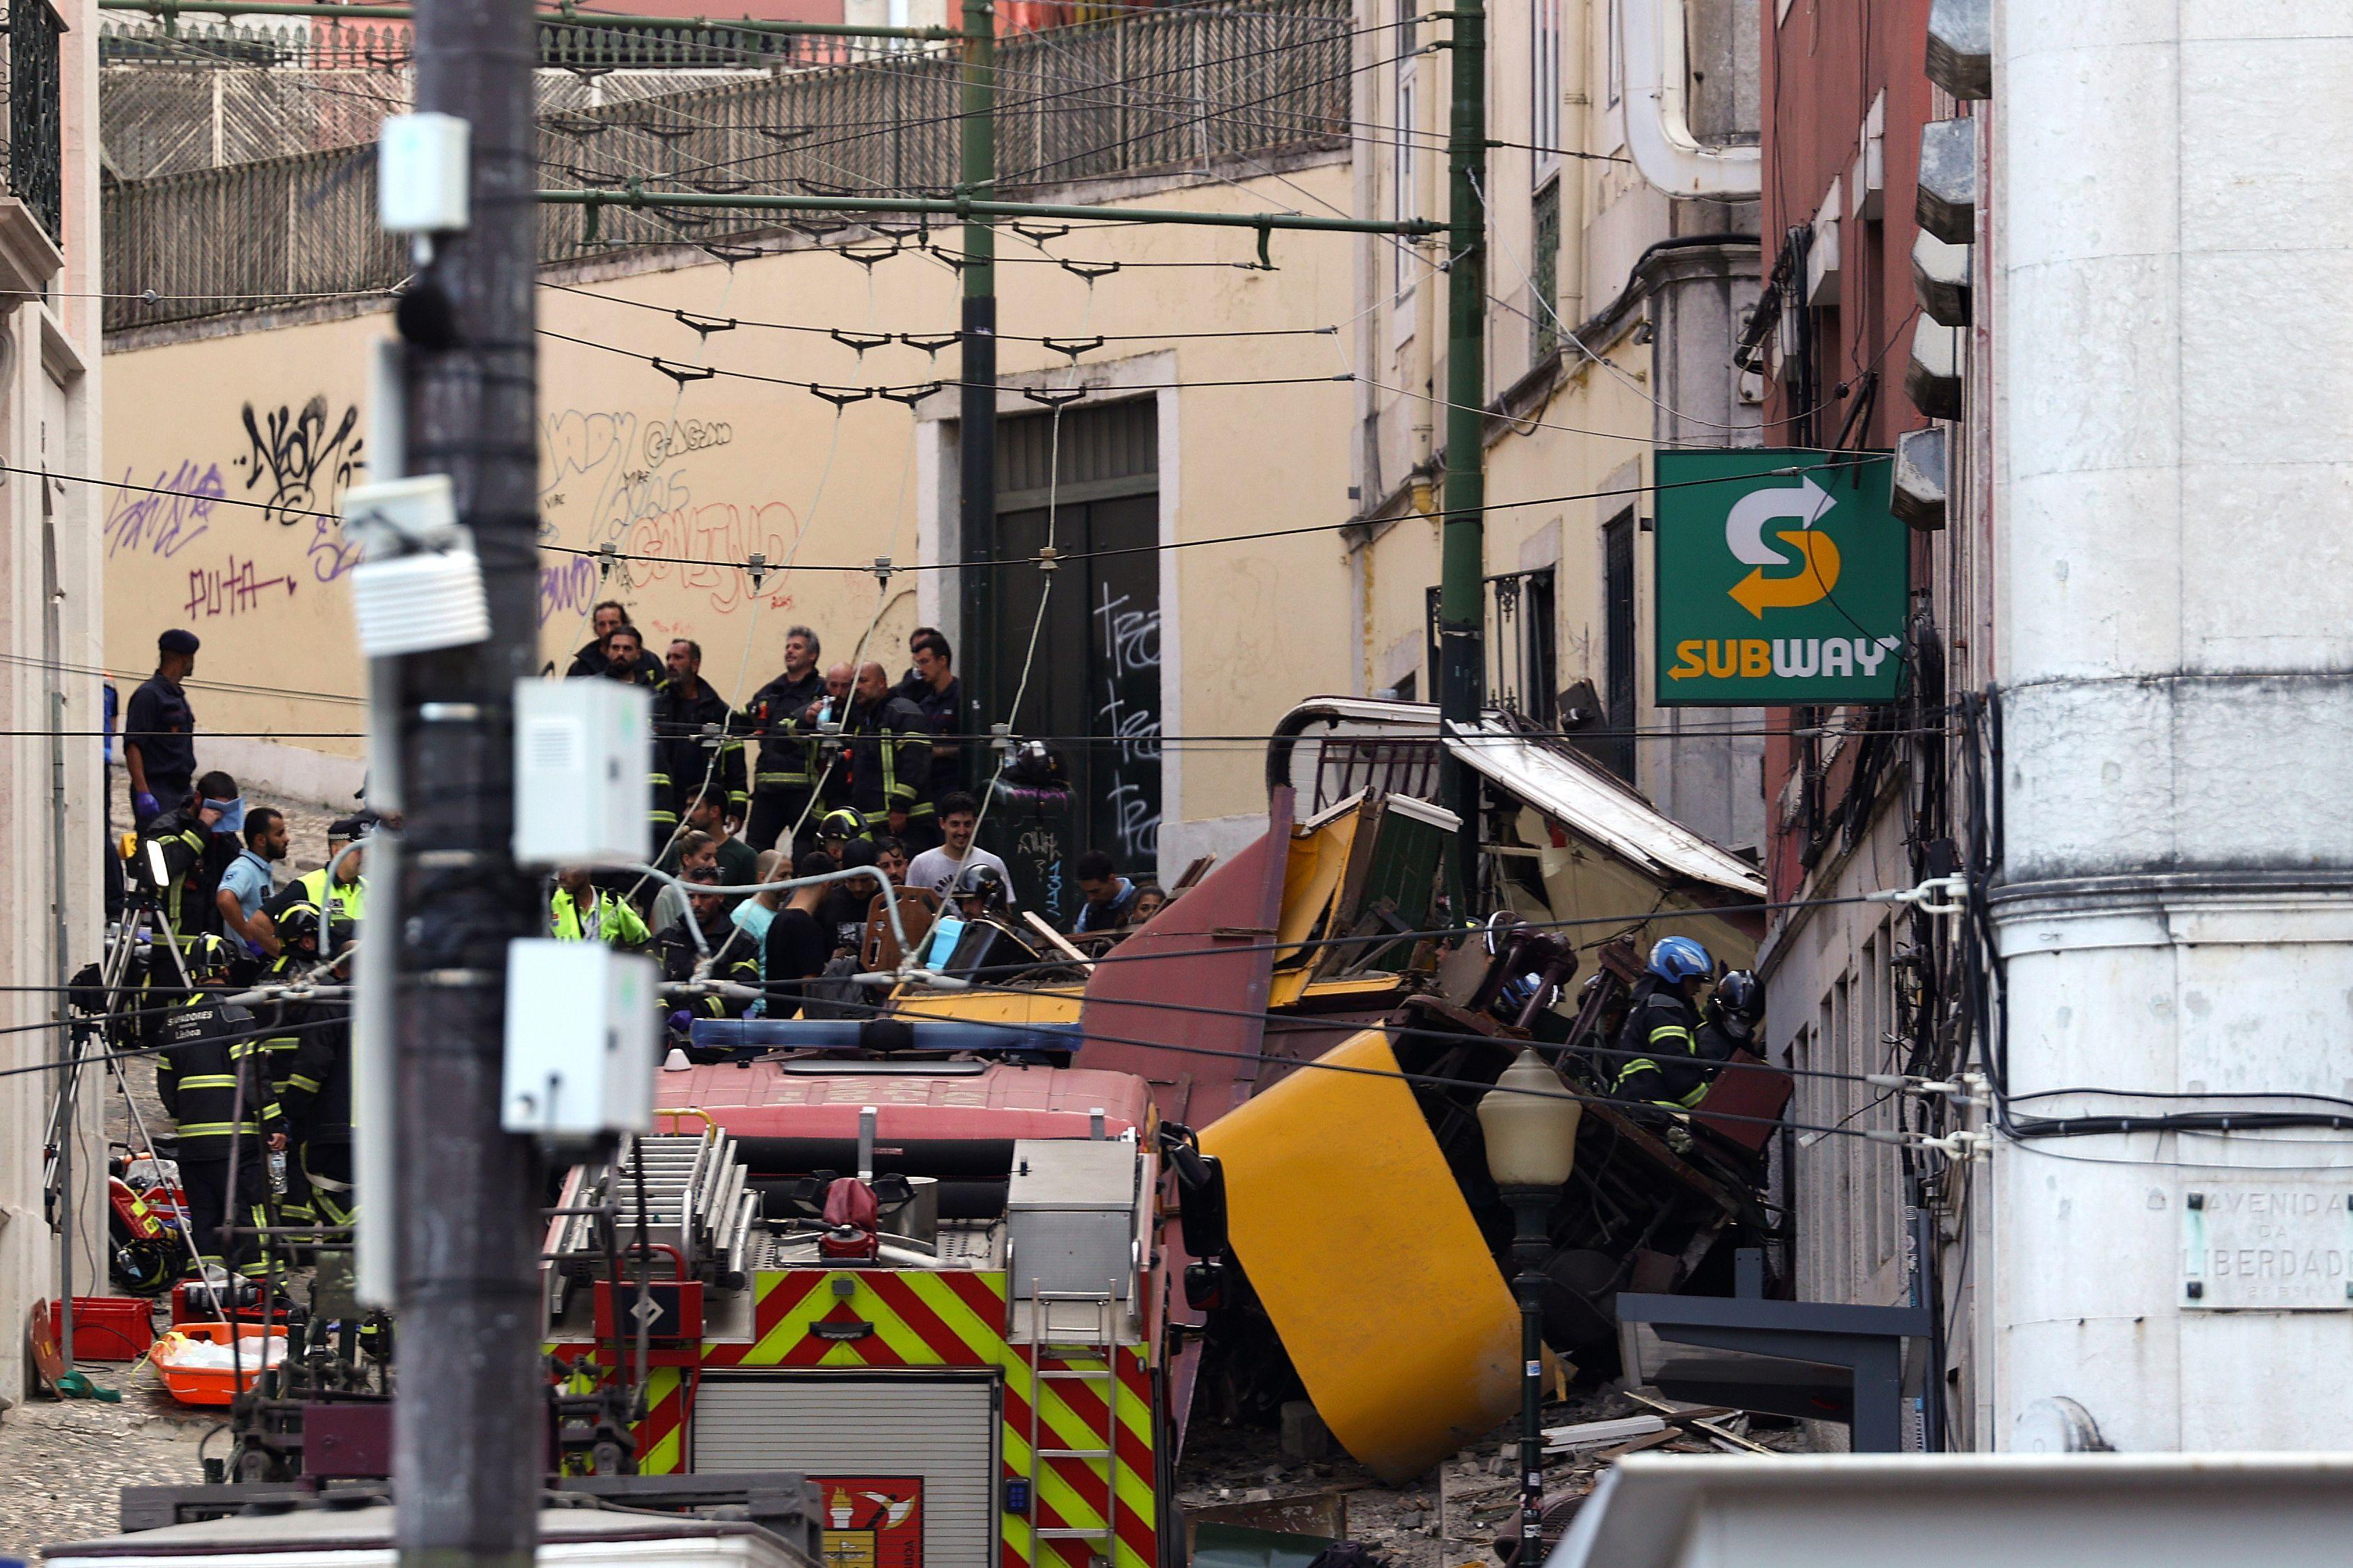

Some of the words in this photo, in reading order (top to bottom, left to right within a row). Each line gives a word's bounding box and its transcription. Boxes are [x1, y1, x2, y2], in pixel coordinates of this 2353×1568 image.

[184, 555, 285, 621] PUTA
[1667, 635, 1902, 681] SUBWAY
[2207, 1192, 2345, 1215] AVENIDA
[2258, 1224, 2287, 1238] DA
